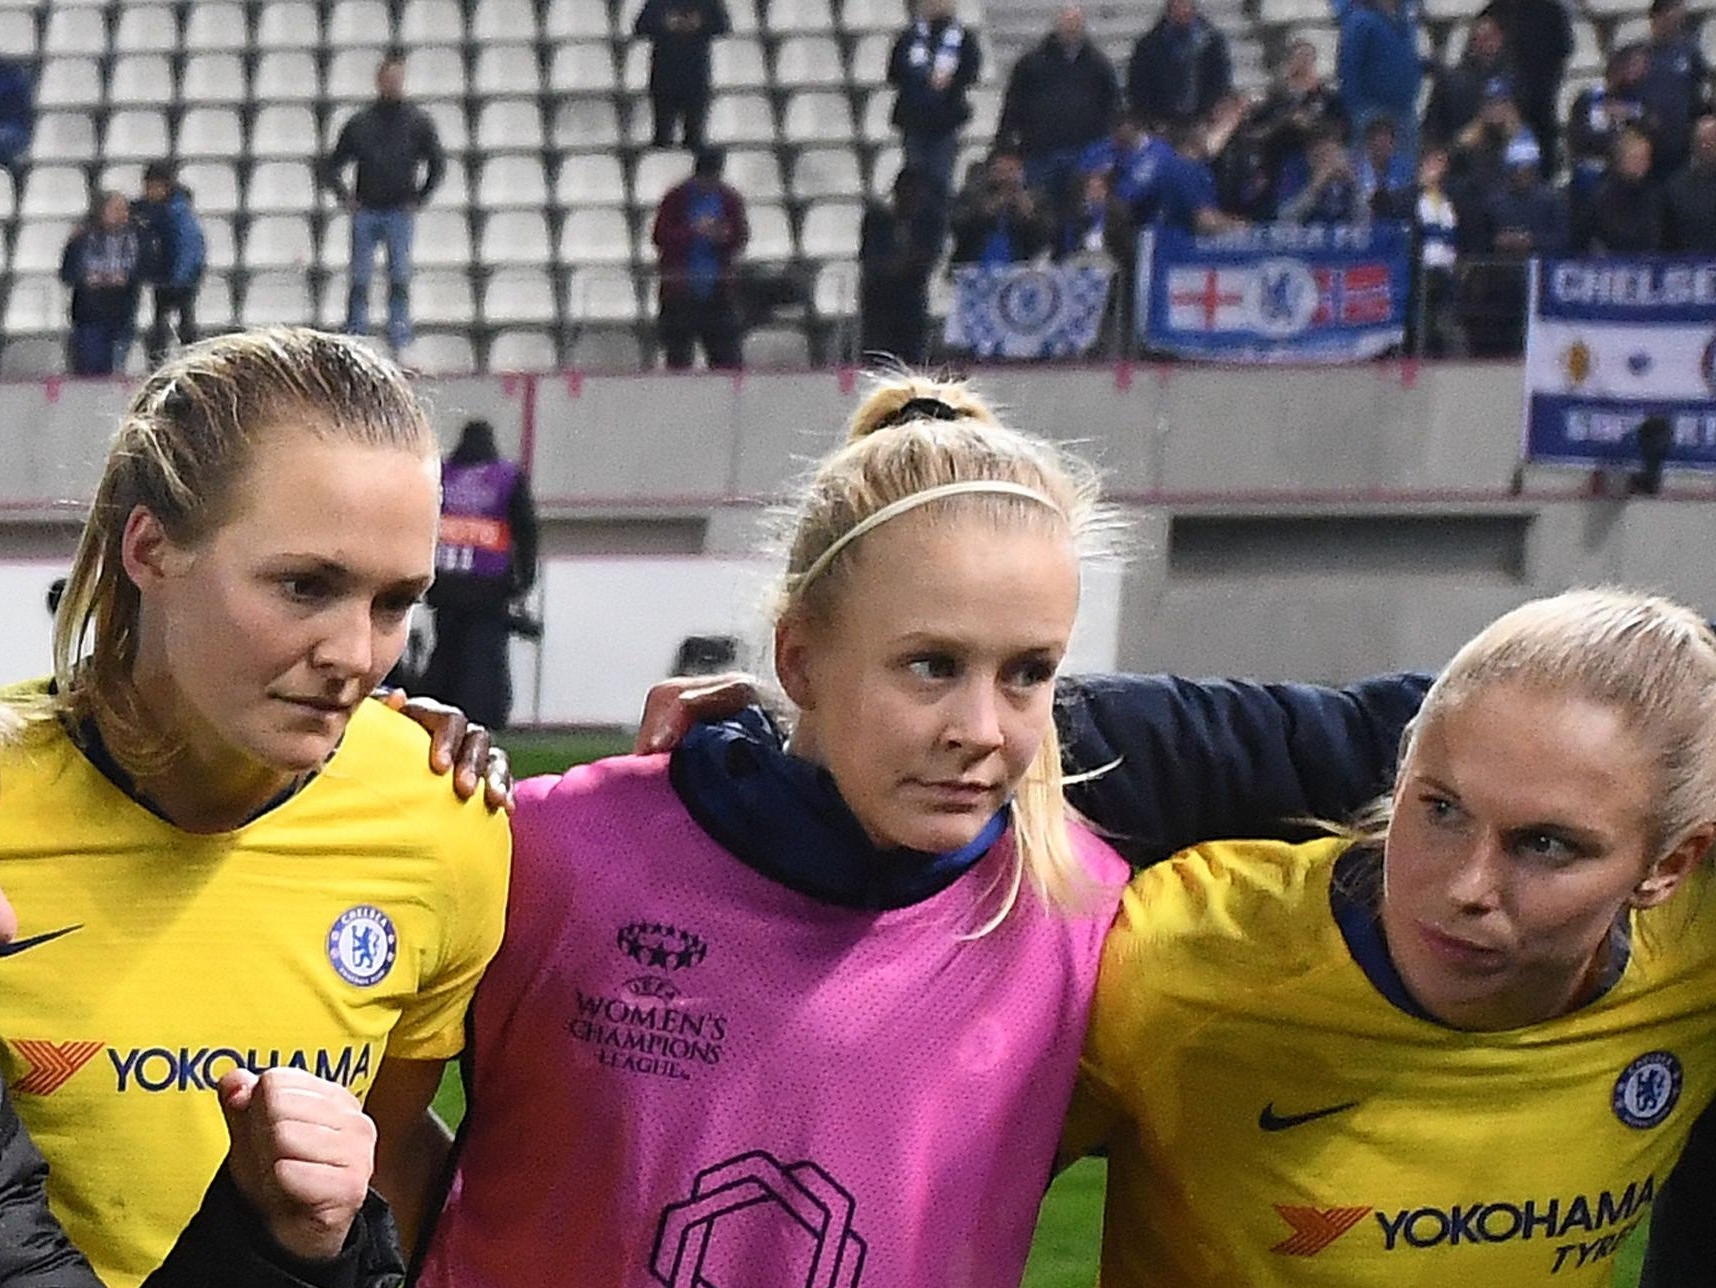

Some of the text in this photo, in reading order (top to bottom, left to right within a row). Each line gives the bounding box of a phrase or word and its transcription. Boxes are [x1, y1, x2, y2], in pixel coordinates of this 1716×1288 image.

[575, 990, 728, 1041] WOMEN'S
[568, 1018, 723, 1065] CHAMPIONS
[596, 1047, 684, 1079] LEAGUE
[1375, 1173, 1654, 1250] YOKOHAMA
